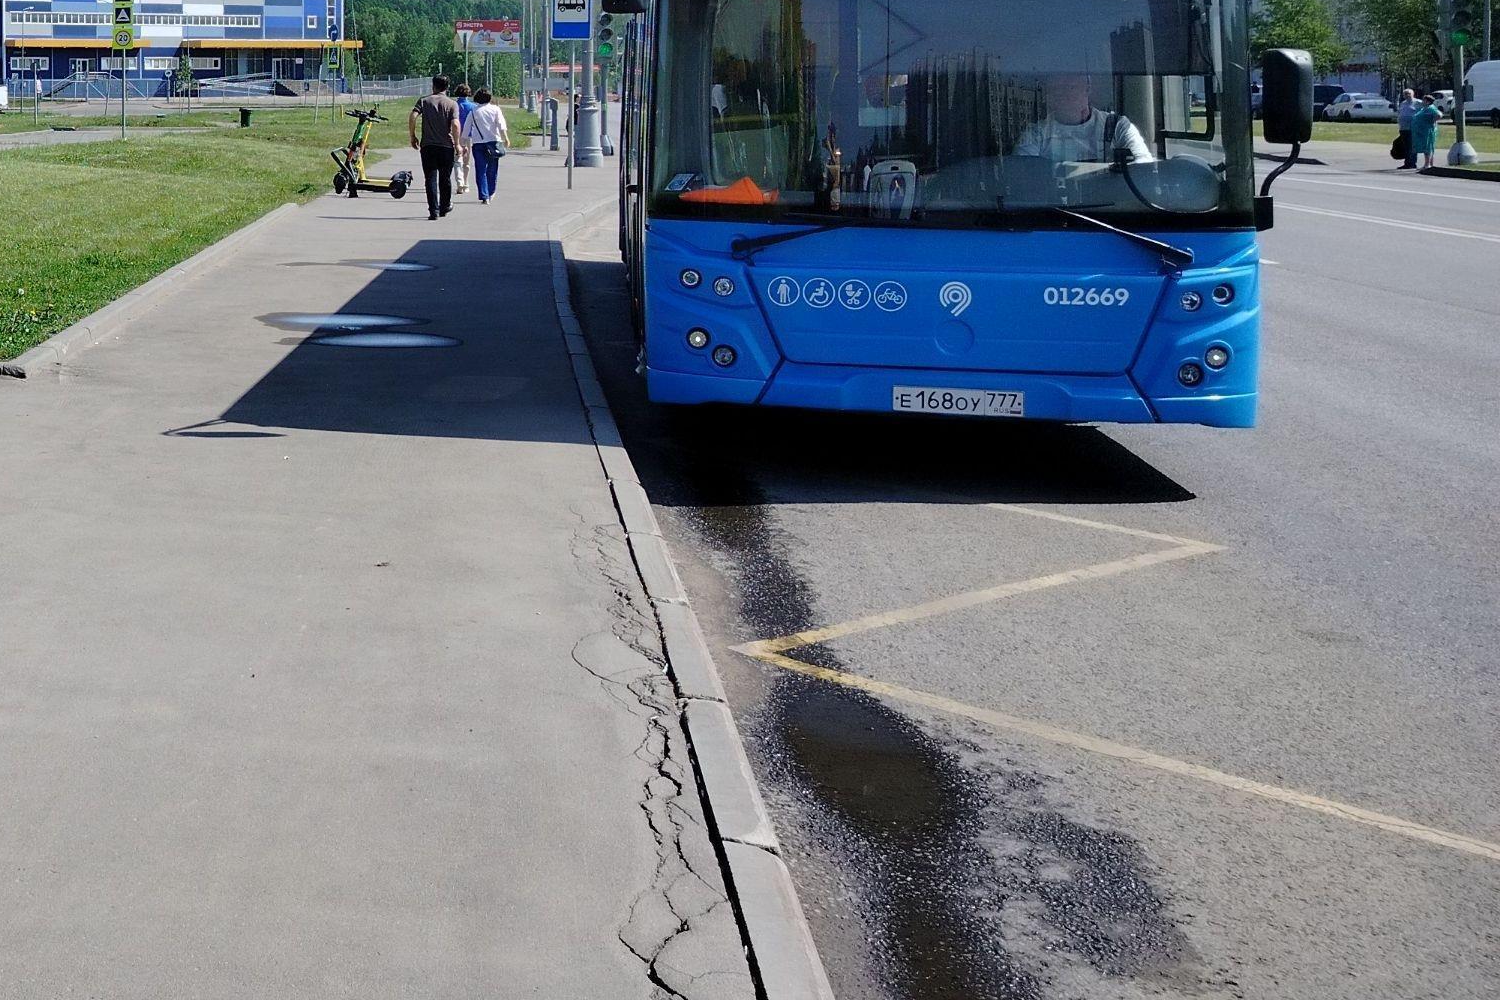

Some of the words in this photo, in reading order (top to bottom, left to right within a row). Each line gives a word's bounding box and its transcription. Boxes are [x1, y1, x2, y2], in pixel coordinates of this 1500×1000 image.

[119, 34, 128, 42] 20
[1043, 286, 1130, 307] 012669
[987, 393, 1018, 408] 777
